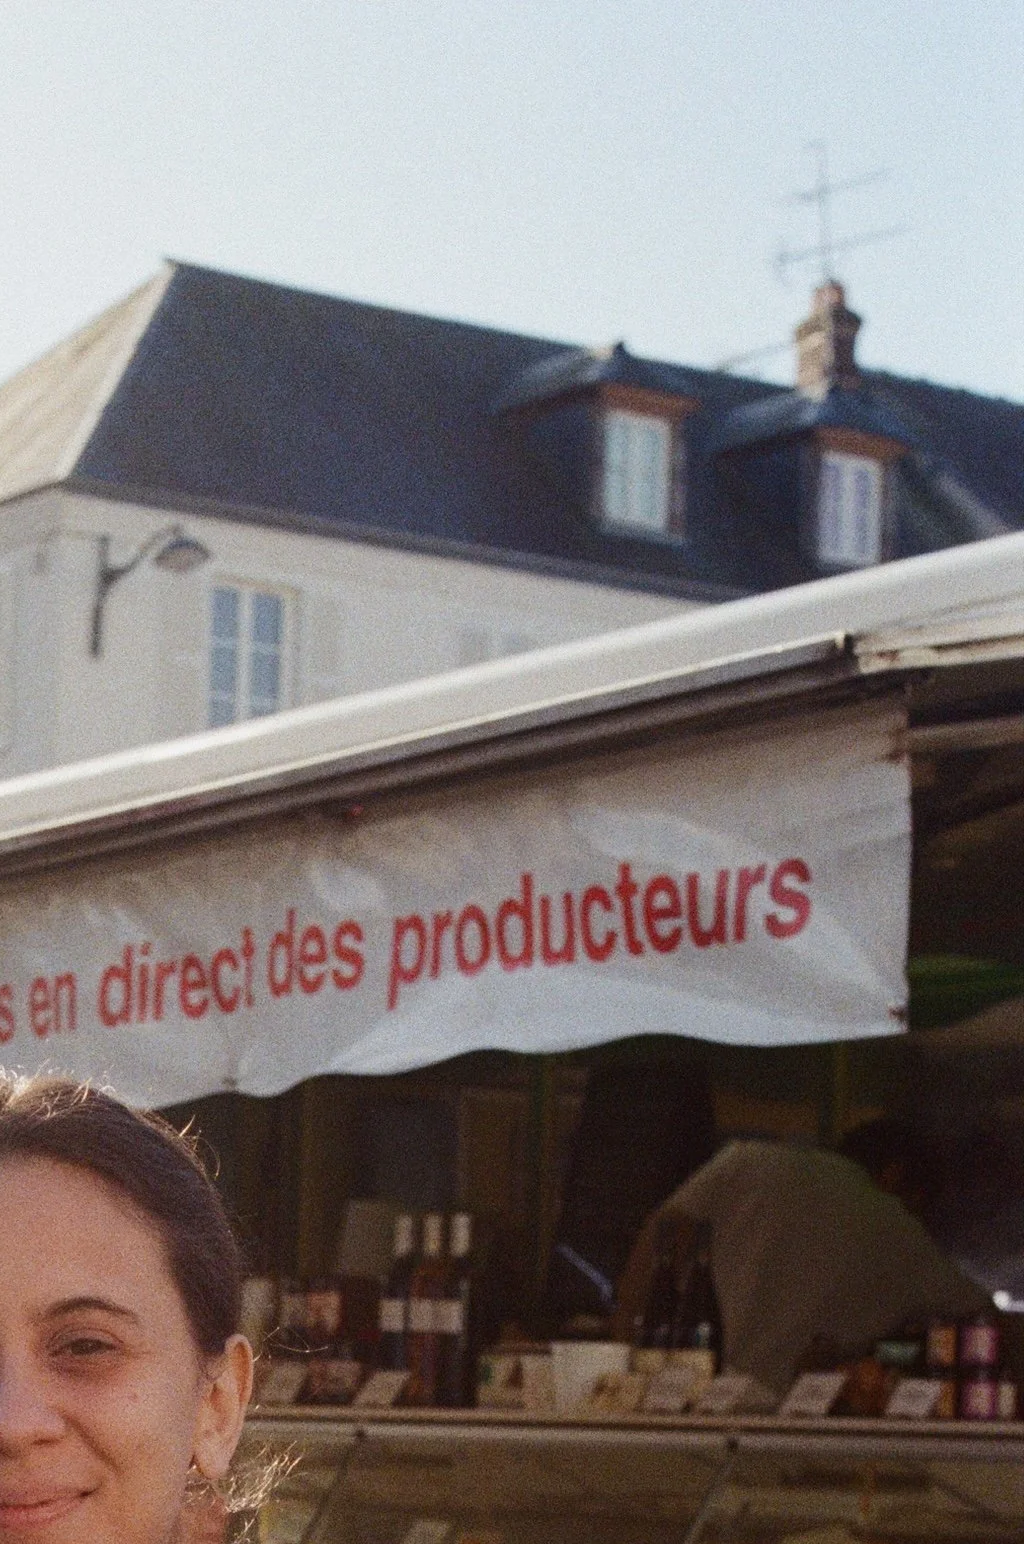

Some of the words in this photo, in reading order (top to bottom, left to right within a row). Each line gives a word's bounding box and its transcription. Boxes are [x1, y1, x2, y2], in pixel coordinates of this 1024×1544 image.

[29, 970, 78, 1039] en
[97, 926, 256, 1029] direct
[267, 906, 366, 999] des
[386, 856, 814, 1012] producteurs
